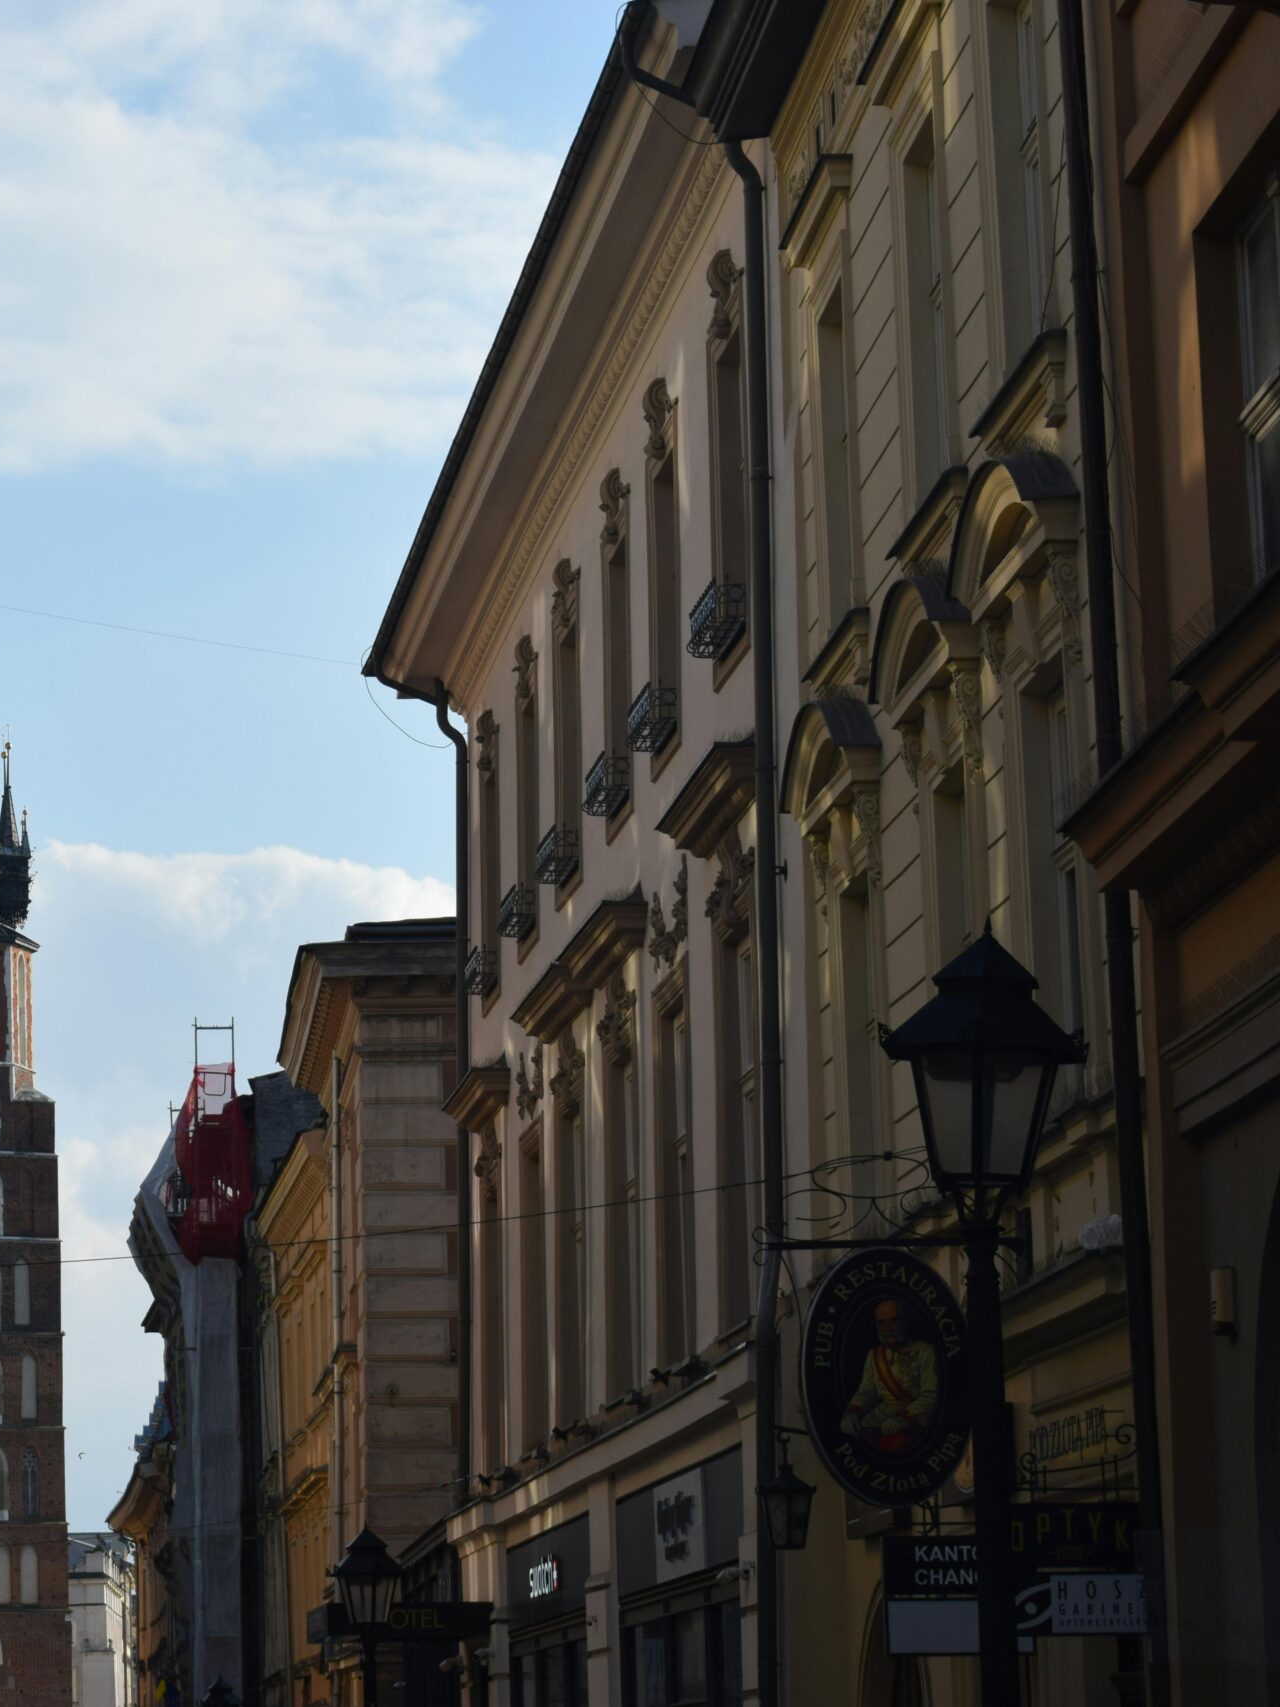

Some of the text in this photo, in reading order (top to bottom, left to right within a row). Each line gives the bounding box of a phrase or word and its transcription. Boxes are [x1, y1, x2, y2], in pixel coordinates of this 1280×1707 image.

[814, 1261, 961, 1368] PUB RESTAURACJA
[834, 1442, 870, 1478] Pod
[927, 1432, 963, 1473] Pipą
[1010, 1508, 1132, 1553] OPTYK
[528, 1553, 554, 1599] swatch
[914, 1568, 978, 1585] CHAN
[388, 1608, 446, 1629] OTEL
